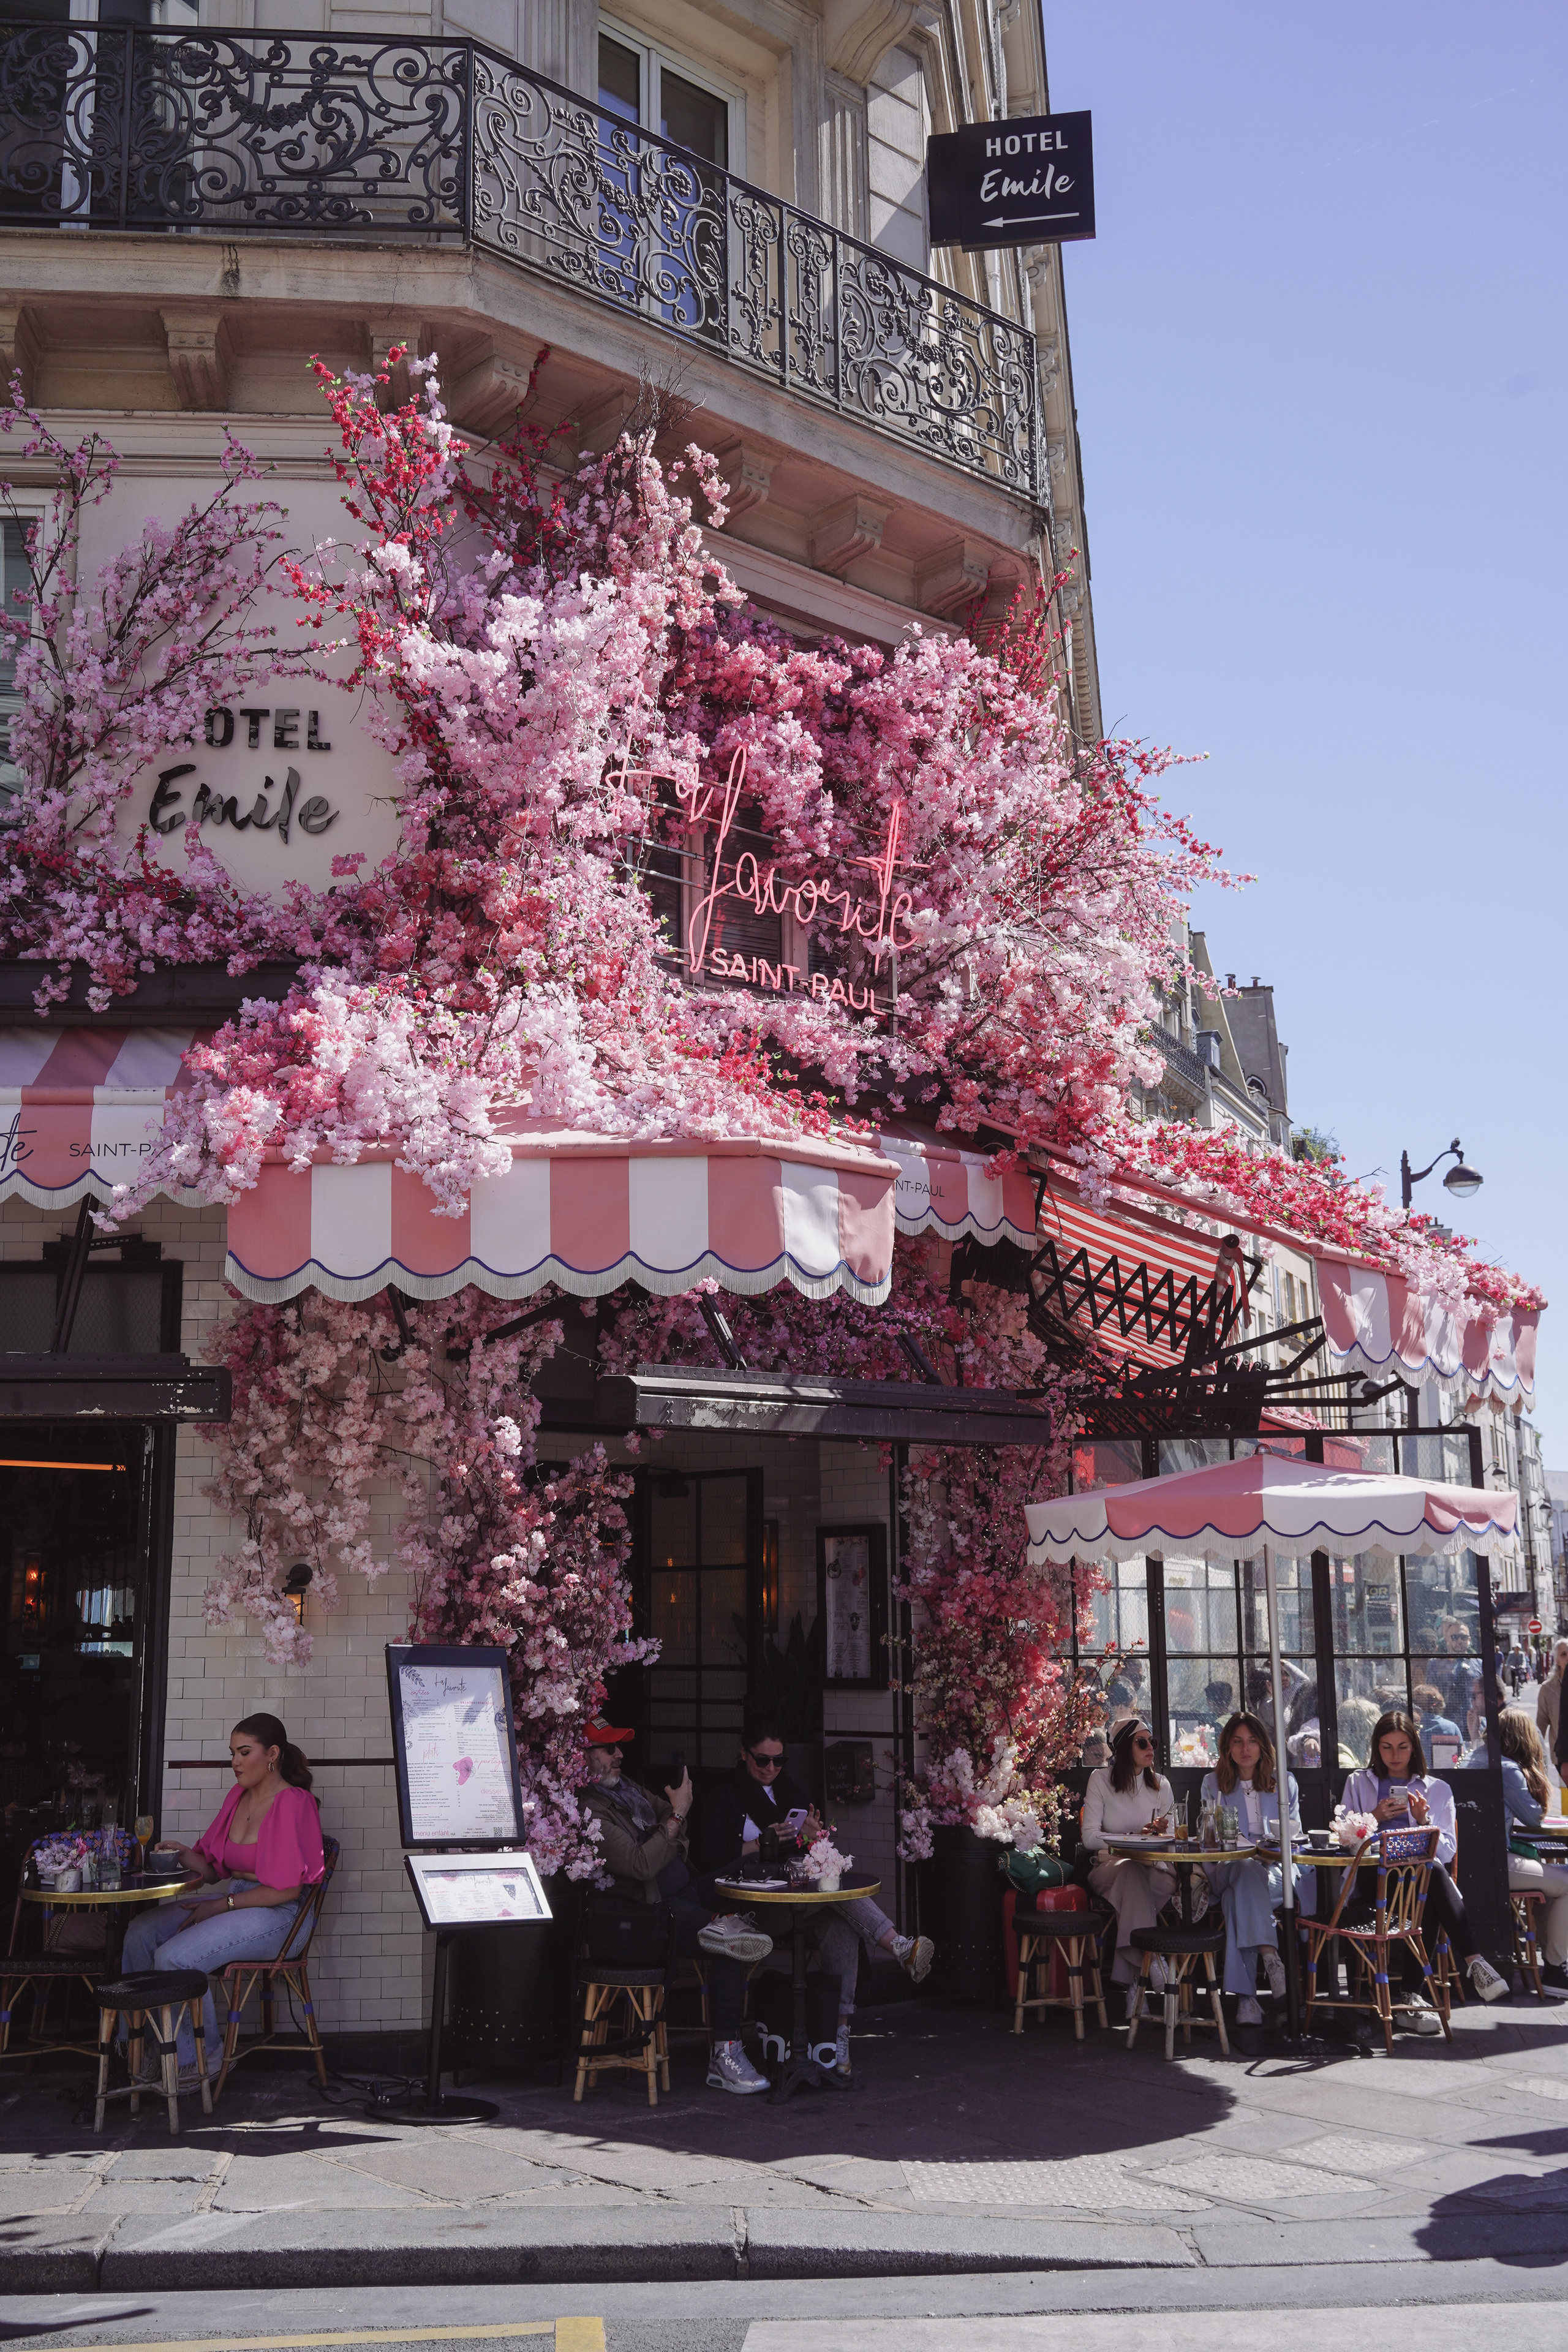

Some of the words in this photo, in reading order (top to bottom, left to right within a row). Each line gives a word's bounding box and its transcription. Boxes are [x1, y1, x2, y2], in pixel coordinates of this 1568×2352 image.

[986, 130, 1068, 157] HOTEL
[980, 163, 1075, 202] Emile
[167, 706, 331, 750] OTEL
[149, 764, 340, 845] Emile
[688, 744, 930, 976] favorite
[709, 948, 886, 1016] SAINT-PAUL
